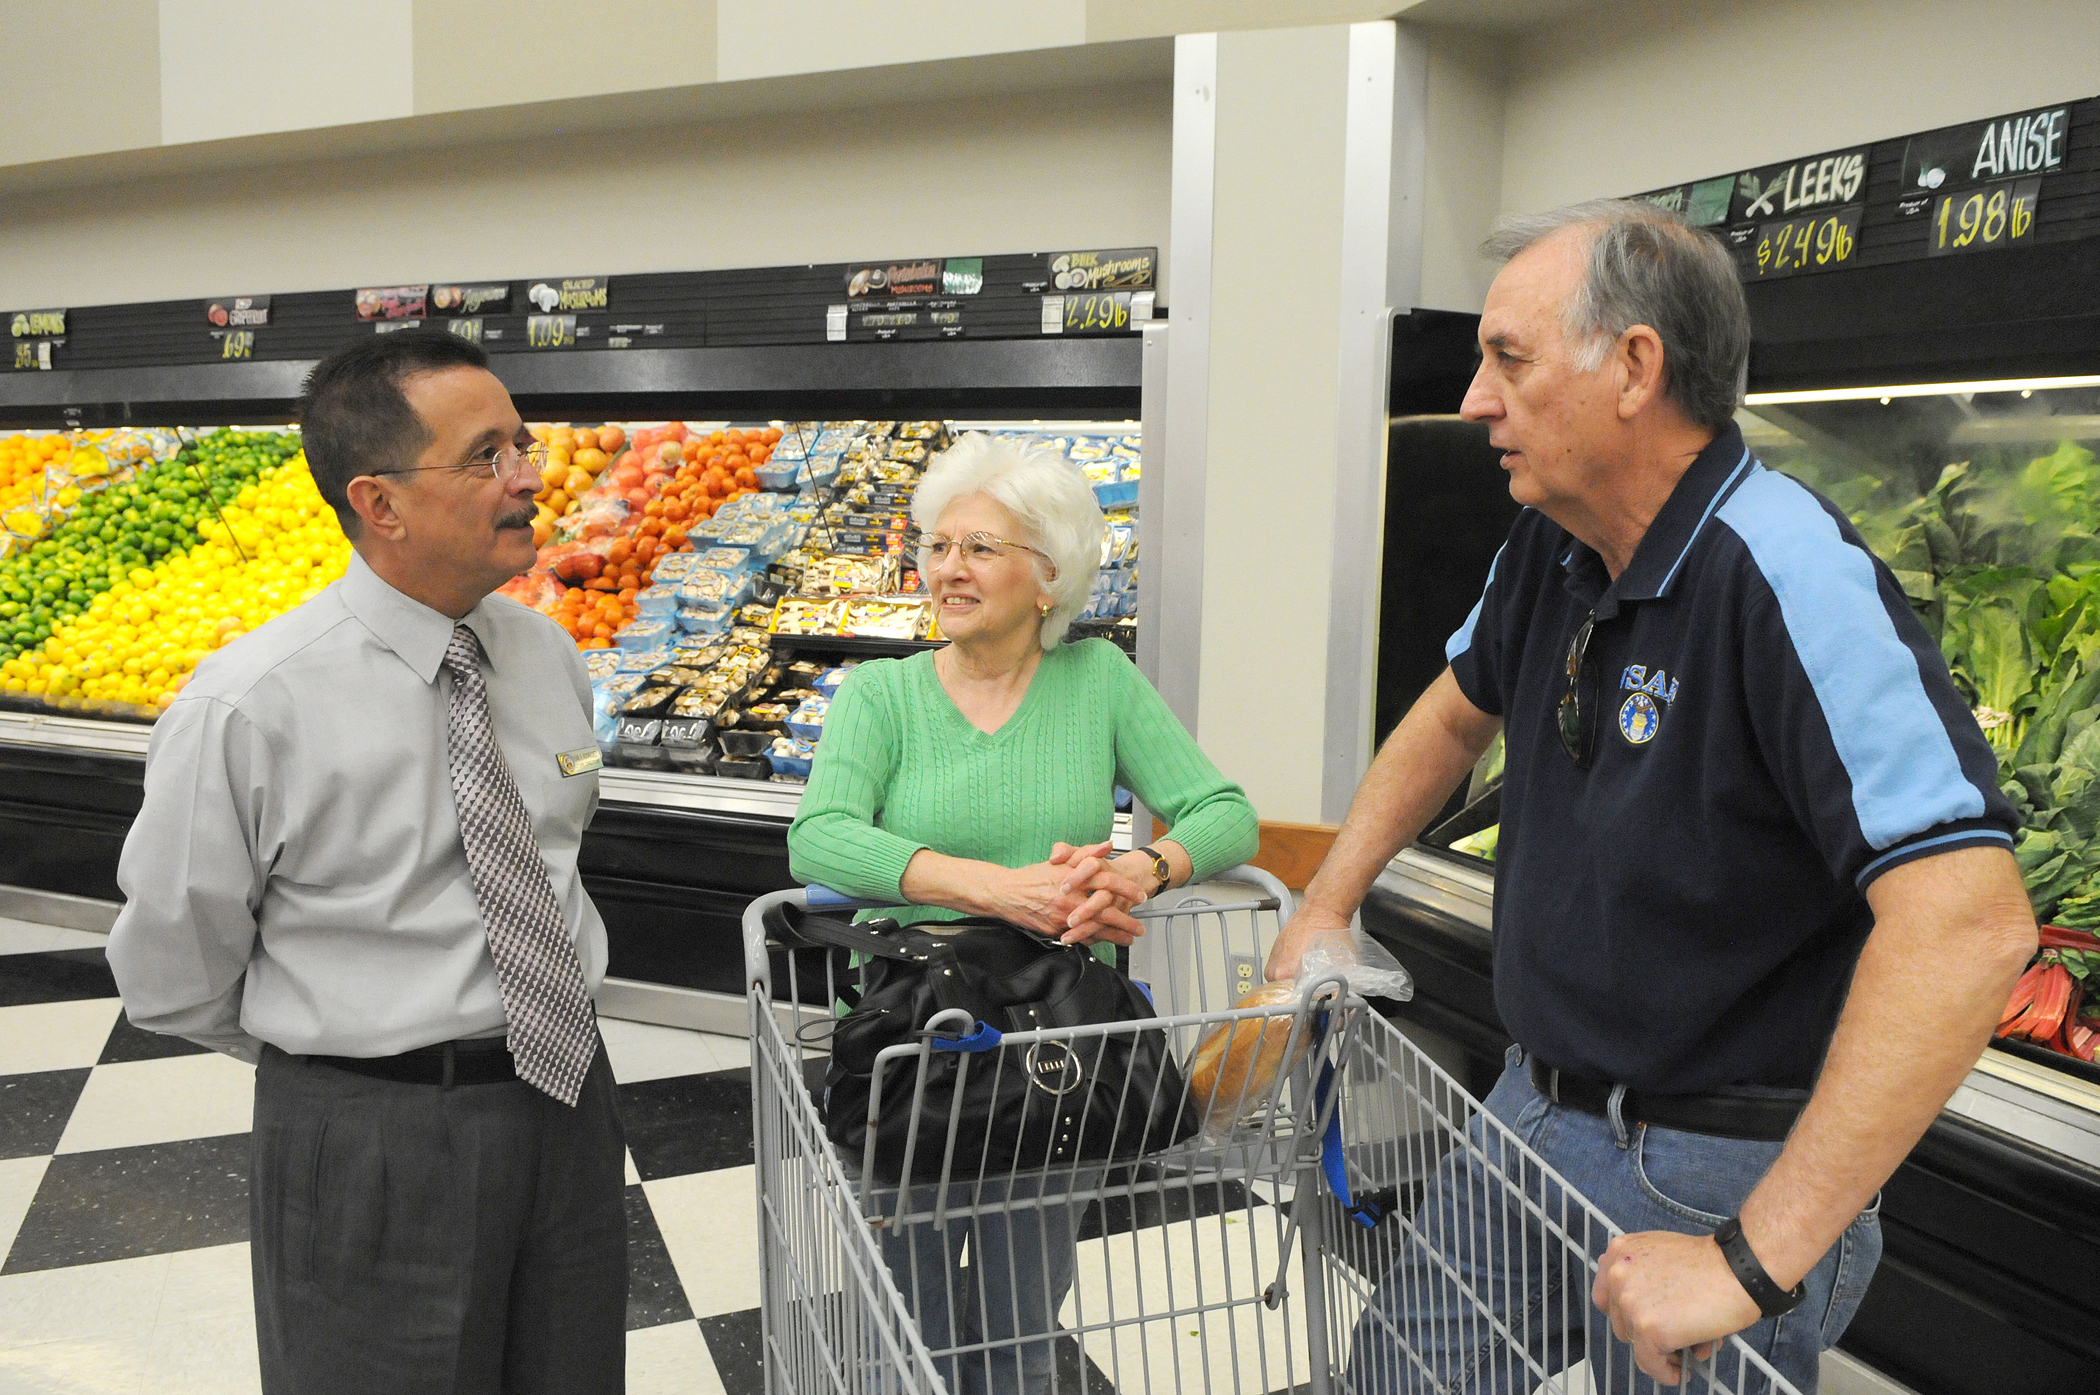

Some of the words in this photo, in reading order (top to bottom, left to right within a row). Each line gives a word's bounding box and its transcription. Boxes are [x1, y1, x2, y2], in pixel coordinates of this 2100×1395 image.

[1971, 109, 2066, 179] ANISE
[1783, 153, 1864, 214] LEEKS
[1084, 257, 1151, 289] Mushrooms
